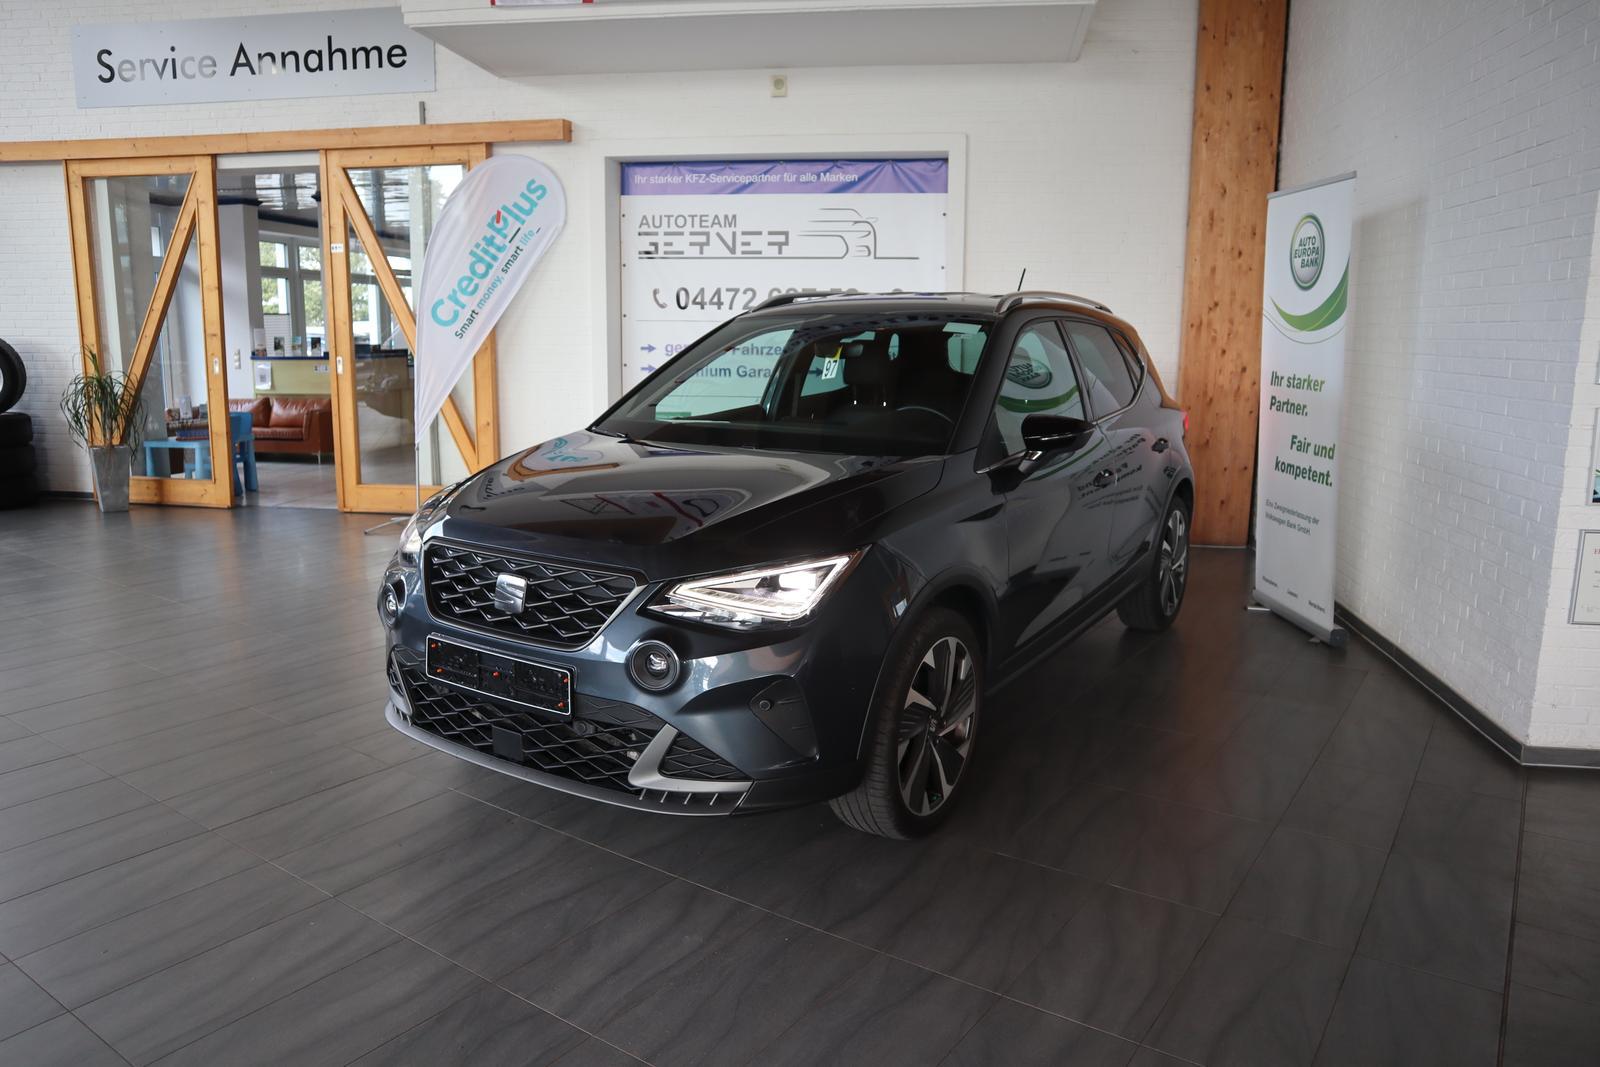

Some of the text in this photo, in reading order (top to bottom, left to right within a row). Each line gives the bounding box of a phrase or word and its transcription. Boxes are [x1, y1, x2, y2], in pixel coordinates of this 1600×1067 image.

[97, 35, 408, 83] Service Annahme
[634, 172, 858, 184] Ihr starker KFZ-Servicepartner für alle Marken
[638, 214, 738, 229] AUTOTEAM
[1298, 235, 1317, 248] AUTO
[1293, 246, 1320, 259] EUROPA
[1300, 257, 1319, 269] BANK
[454, 309, 479, 339] Smart
[501, 246, 524, 274] smart
[825, 359, 838, 377] 97
[1270, 370, 1325, 393] Ihr starker
[1269, 395, 1308, 416] Partner.
[1290, 434, 1336, 460] Fair und
[1274, 455, 1333, 487] kompetent.
